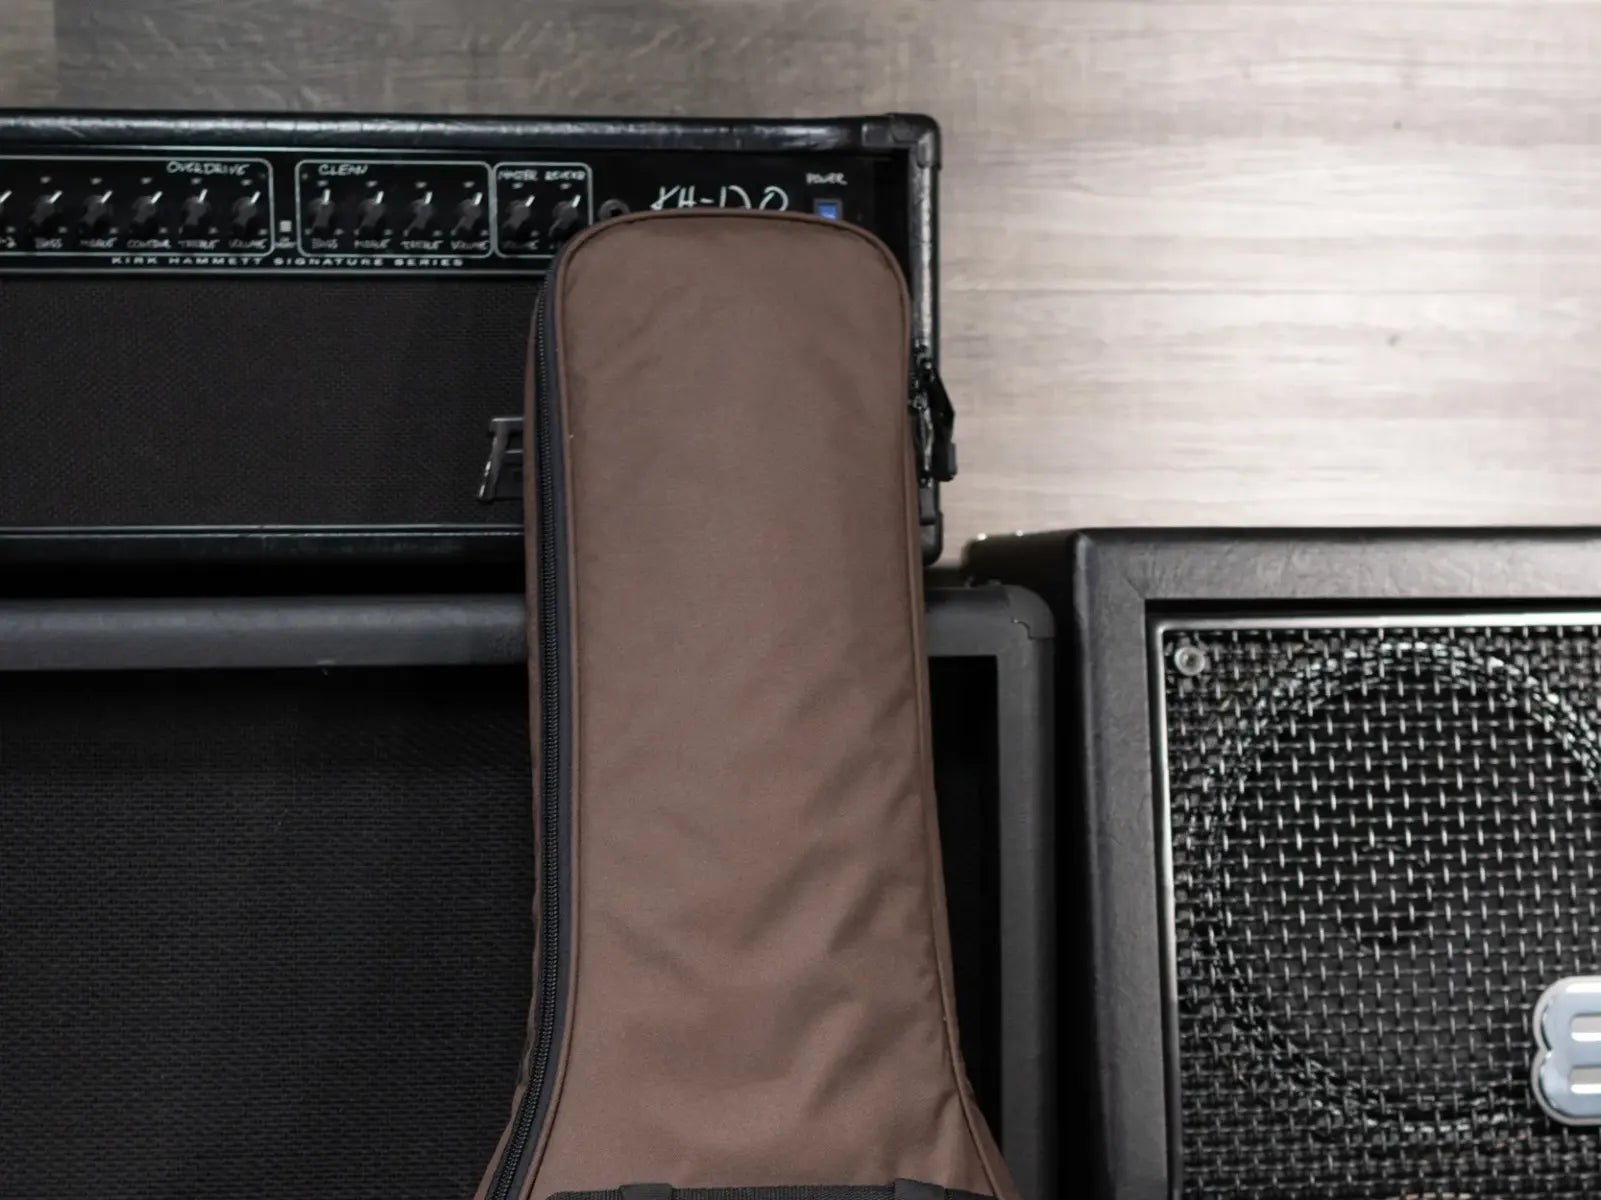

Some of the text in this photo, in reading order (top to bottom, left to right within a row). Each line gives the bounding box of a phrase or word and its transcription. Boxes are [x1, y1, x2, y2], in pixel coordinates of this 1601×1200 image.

[166, 160, 250, 176] OVERDRIVE
[318, 163, 368, 176] CLEAN
[111, 256, 464, 267] KIRK HAMMETT SIGNATURE SERIES
